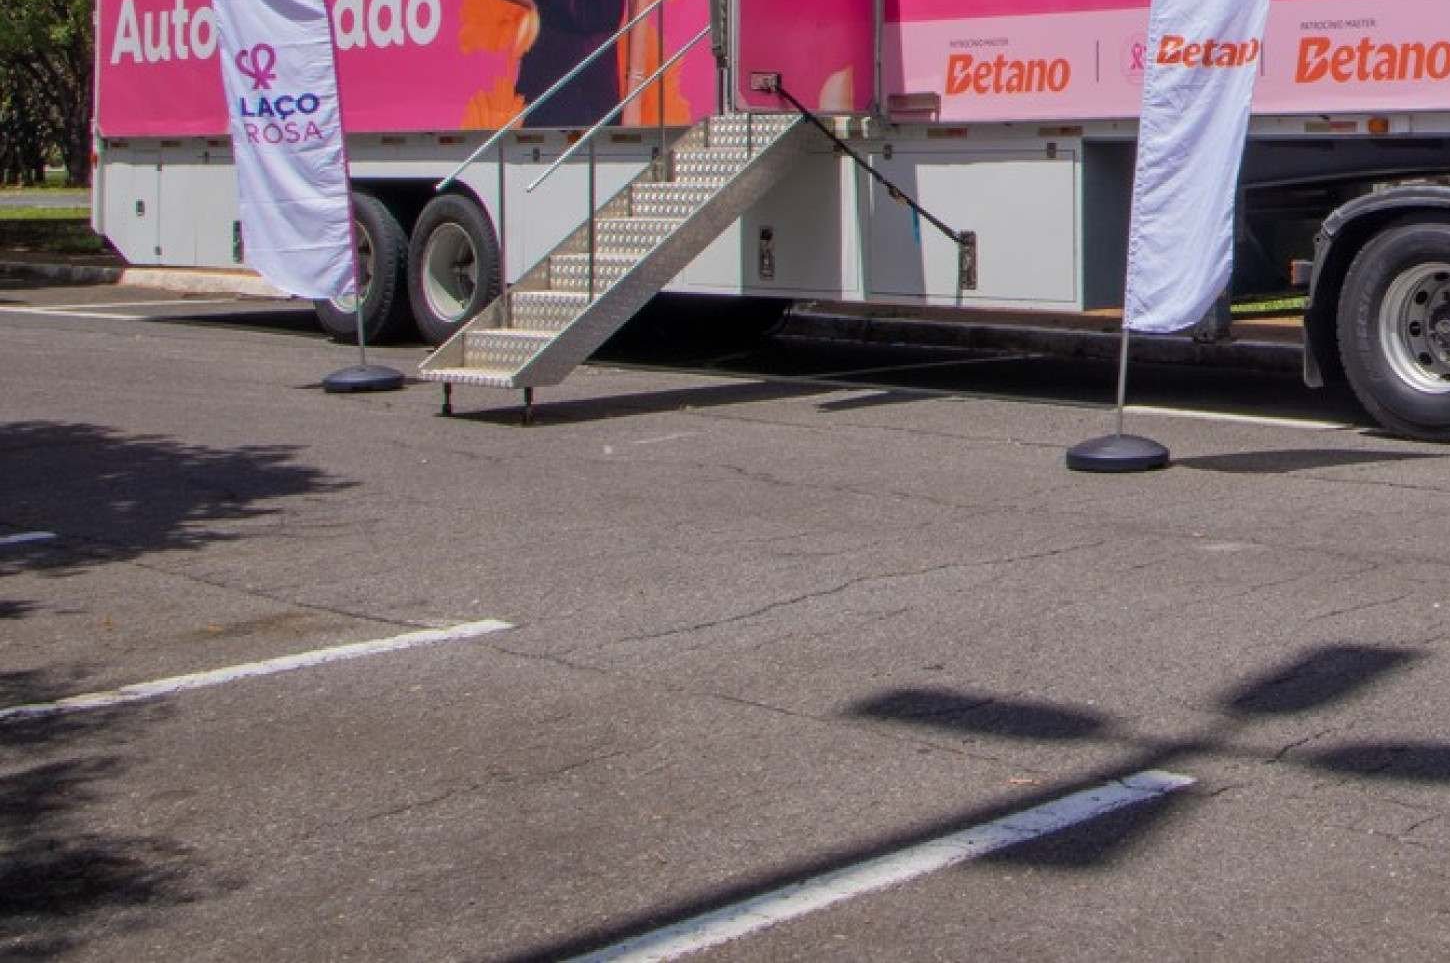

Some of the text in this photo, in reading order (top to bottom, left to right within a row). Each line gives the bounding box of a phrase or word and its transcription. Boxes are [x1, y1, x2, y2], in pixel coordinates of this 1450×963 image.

[945, 54, 1070, 95] Betano
[239, 93, 321, 119] LAÇO
[244, 121, 323, 144] ROSA
